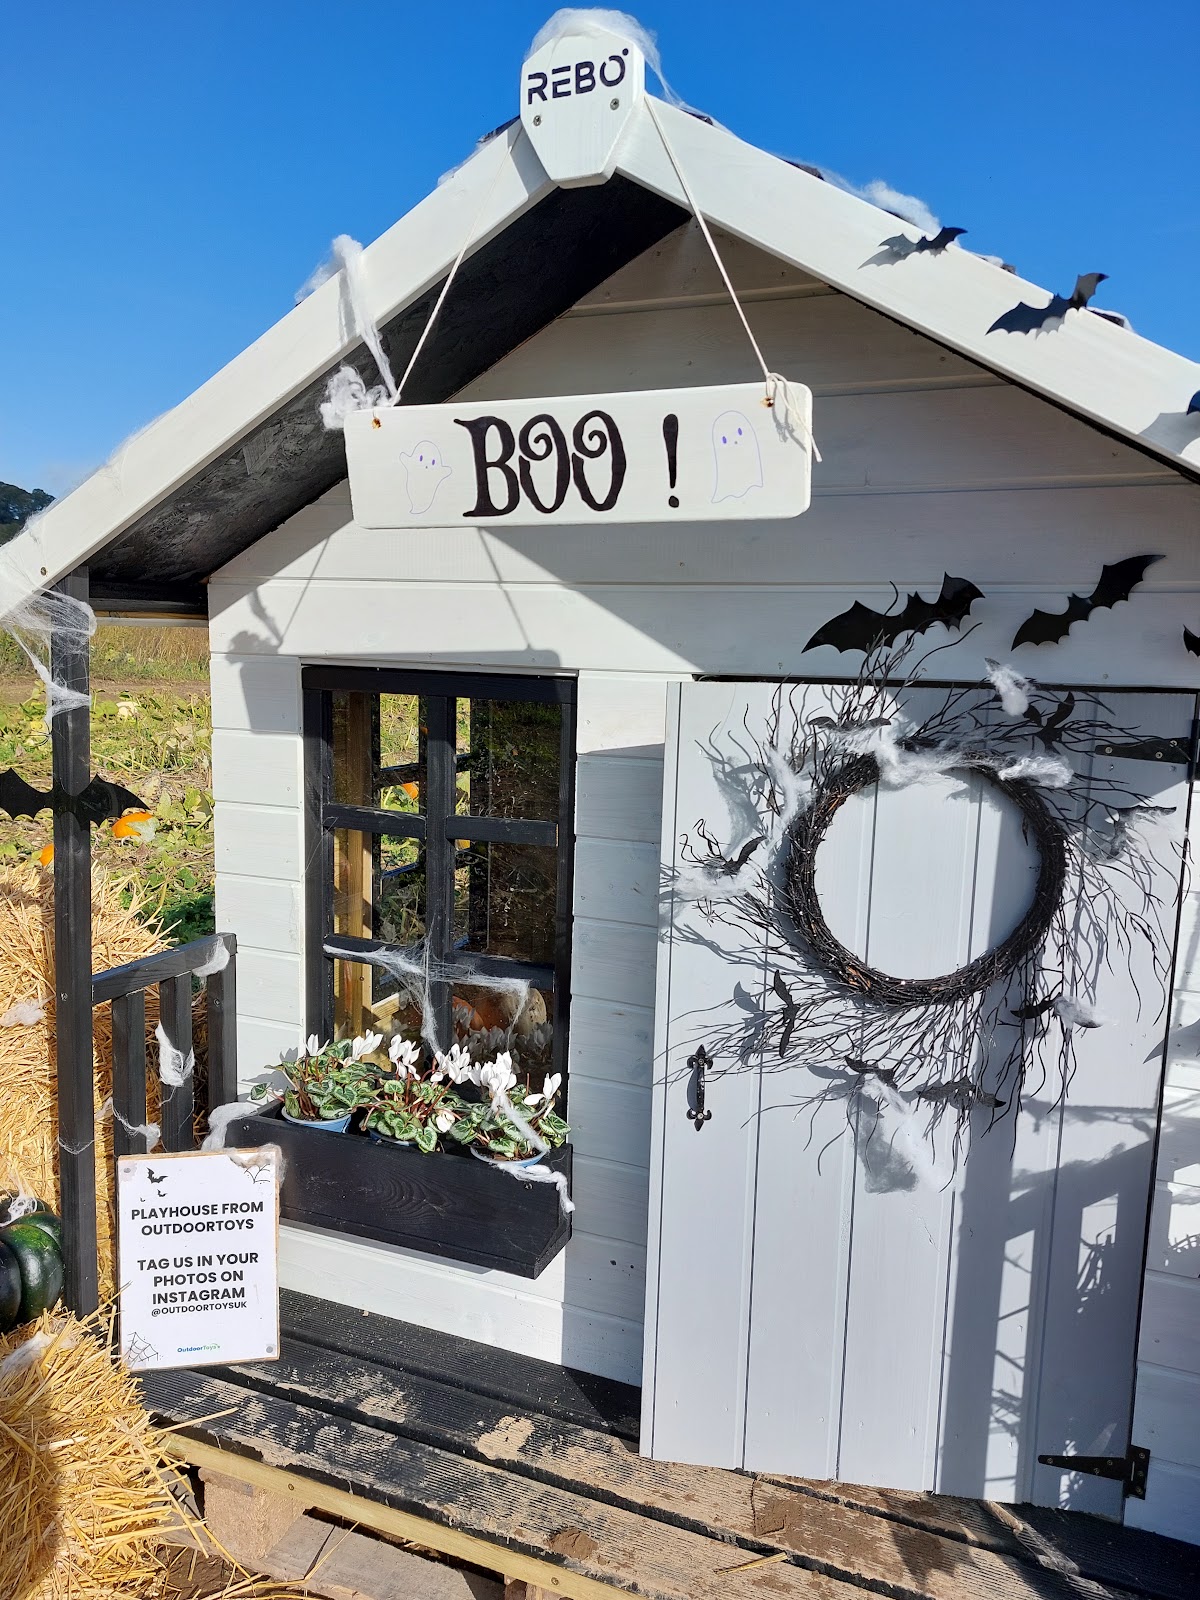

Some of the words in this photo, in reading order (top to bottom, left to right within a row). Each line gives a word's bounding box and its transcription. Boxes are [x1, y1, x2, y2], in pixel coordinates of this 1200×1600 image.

[528, 48, 629, 105] REBO
[453, 410, 627, 517] BOO
[131, 1204, 218, 1220] PLAYHOUSE
[222, 1201, 264, 1214] FROM
[141, 1219, 254, 1235] OUTDOORTOYS
[137, 1258, 170, 1271] TAG
[173, 1256, 193, 1268] US
[197, 1255, 213, 1266] IN
[216, 1252, 259, 1265] YOUR
[153, 1272, 217, 1287] PHOTOS
[220, 1270, 244, 1282] ON
[152, 1287, 245, 1304] INSTAGRAM
[151, 1301, 247, 1317] @OUTDOORTOYSUK
[177, 1344, 217, 1353] OutdoorToys
